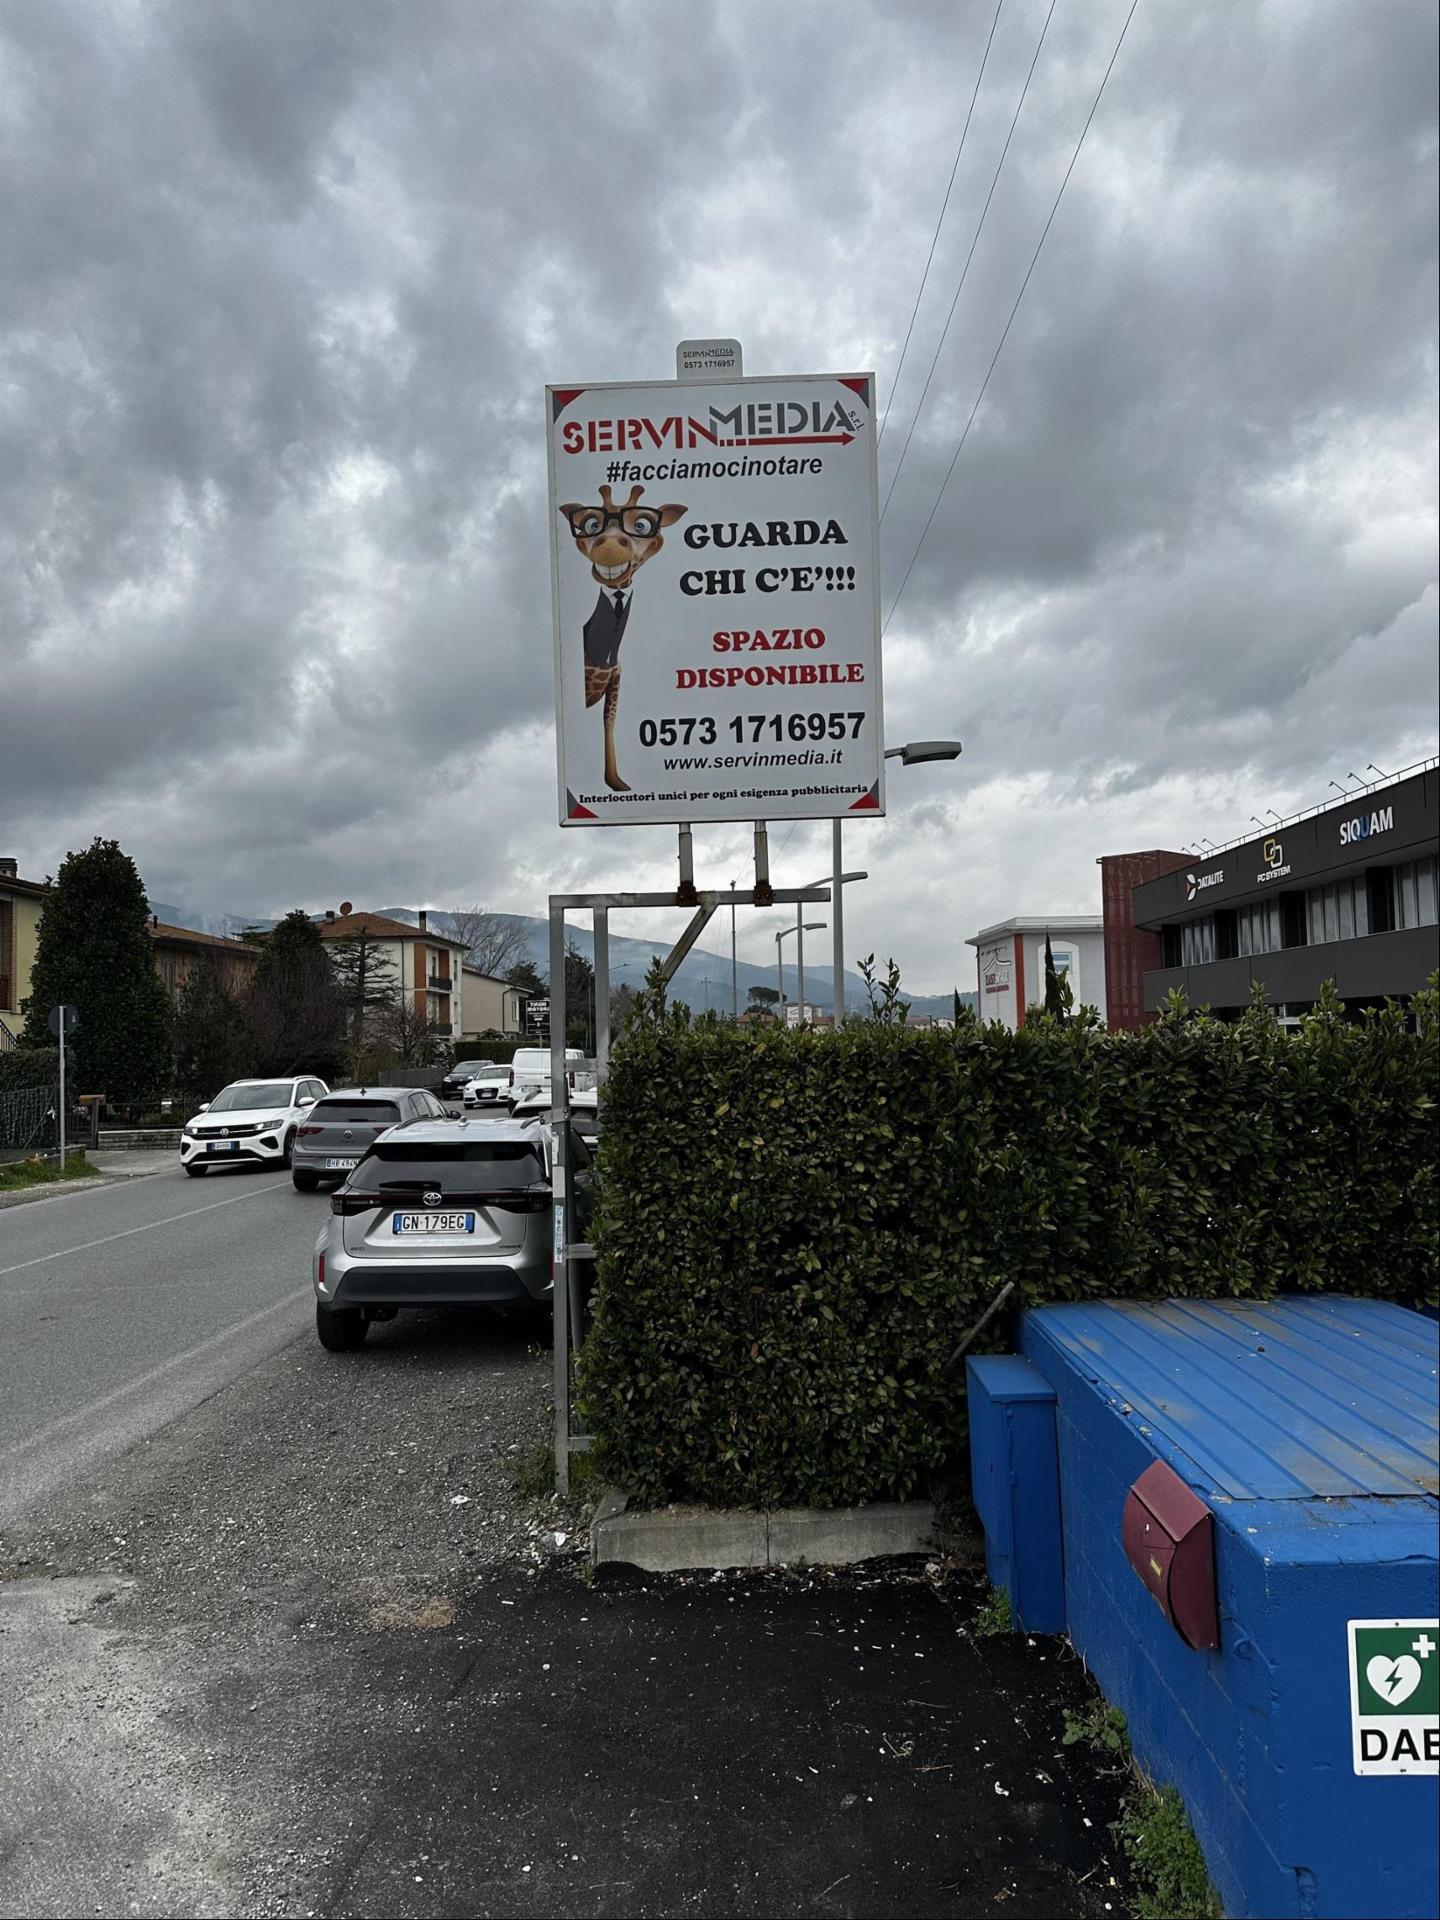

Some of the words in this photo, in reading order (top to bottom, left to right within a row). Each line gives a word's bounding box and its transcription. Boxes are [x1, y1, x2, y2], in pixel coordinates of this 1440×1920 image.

[684, 361, 703, 369] 0573
[704, 360, 735, 368] 1716957
[606, 455, 823, 483] #facciamocinotare
[683, 519, 849, 550] GUARDA
[679, 569, 747, 597] CHI
[713, 628, 826, 652] SPAZIO
[676, 663, 865, 689] DISPONIBILE
[639, 717, 717, 747] 0573
[729, 712, 866, 744] 1716957
[663, 749, 843, 771] www.servinmedia.it
[579, 791, 655, 804] Interlocutori
[658, 790, 688, 802] unici
[690, 791, 711, 803] per
[712, 787, 738, 801] ogni
[740, 786, 789, 800] esigenza
[791, 783, 868, 799] pubblicitaria
[1340, 806, 1394, 845] SIQUAM
[1197, 870, 1224, 890] DATALITE
[1257, 873, 1266, 884] PC
[1265, 865, 1291, 881] SYSTEM
[402, 1216, 419, 1230] GN
[424, 1215, 465, 1229] 179EG
[1361, 1728, 1439, 1761] DAE
